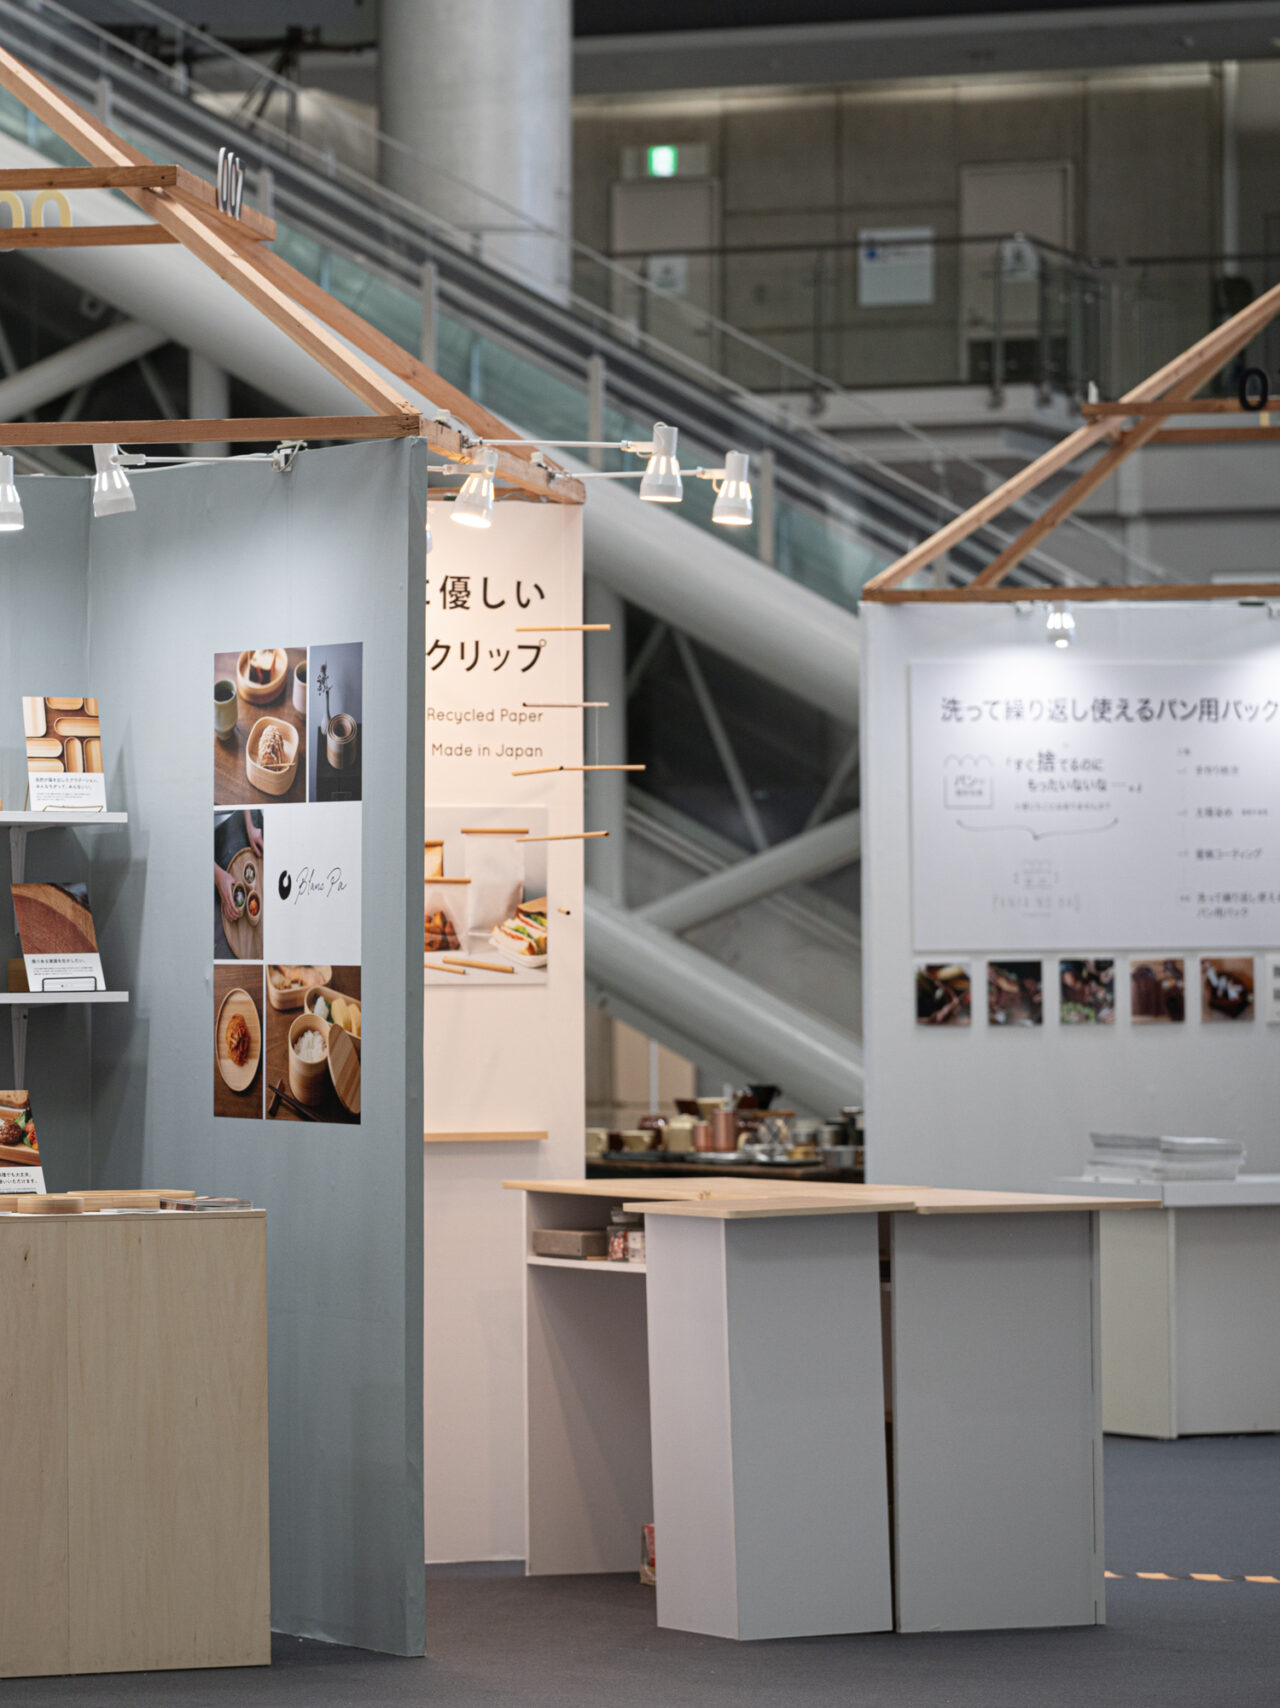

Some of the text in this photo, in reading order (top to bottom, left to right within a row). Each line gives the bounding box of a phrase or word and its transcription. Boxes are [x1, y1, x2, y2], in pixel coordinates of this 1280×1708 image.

[426, 575, 545, 610] 優しい
[427, 638, 547, 673] クリップ
[427, 707, 544, 724] Recycled Paper
[431, 743, 544, 760] Made in Japan
[294, 866, 347, 906] Blanc Pa
